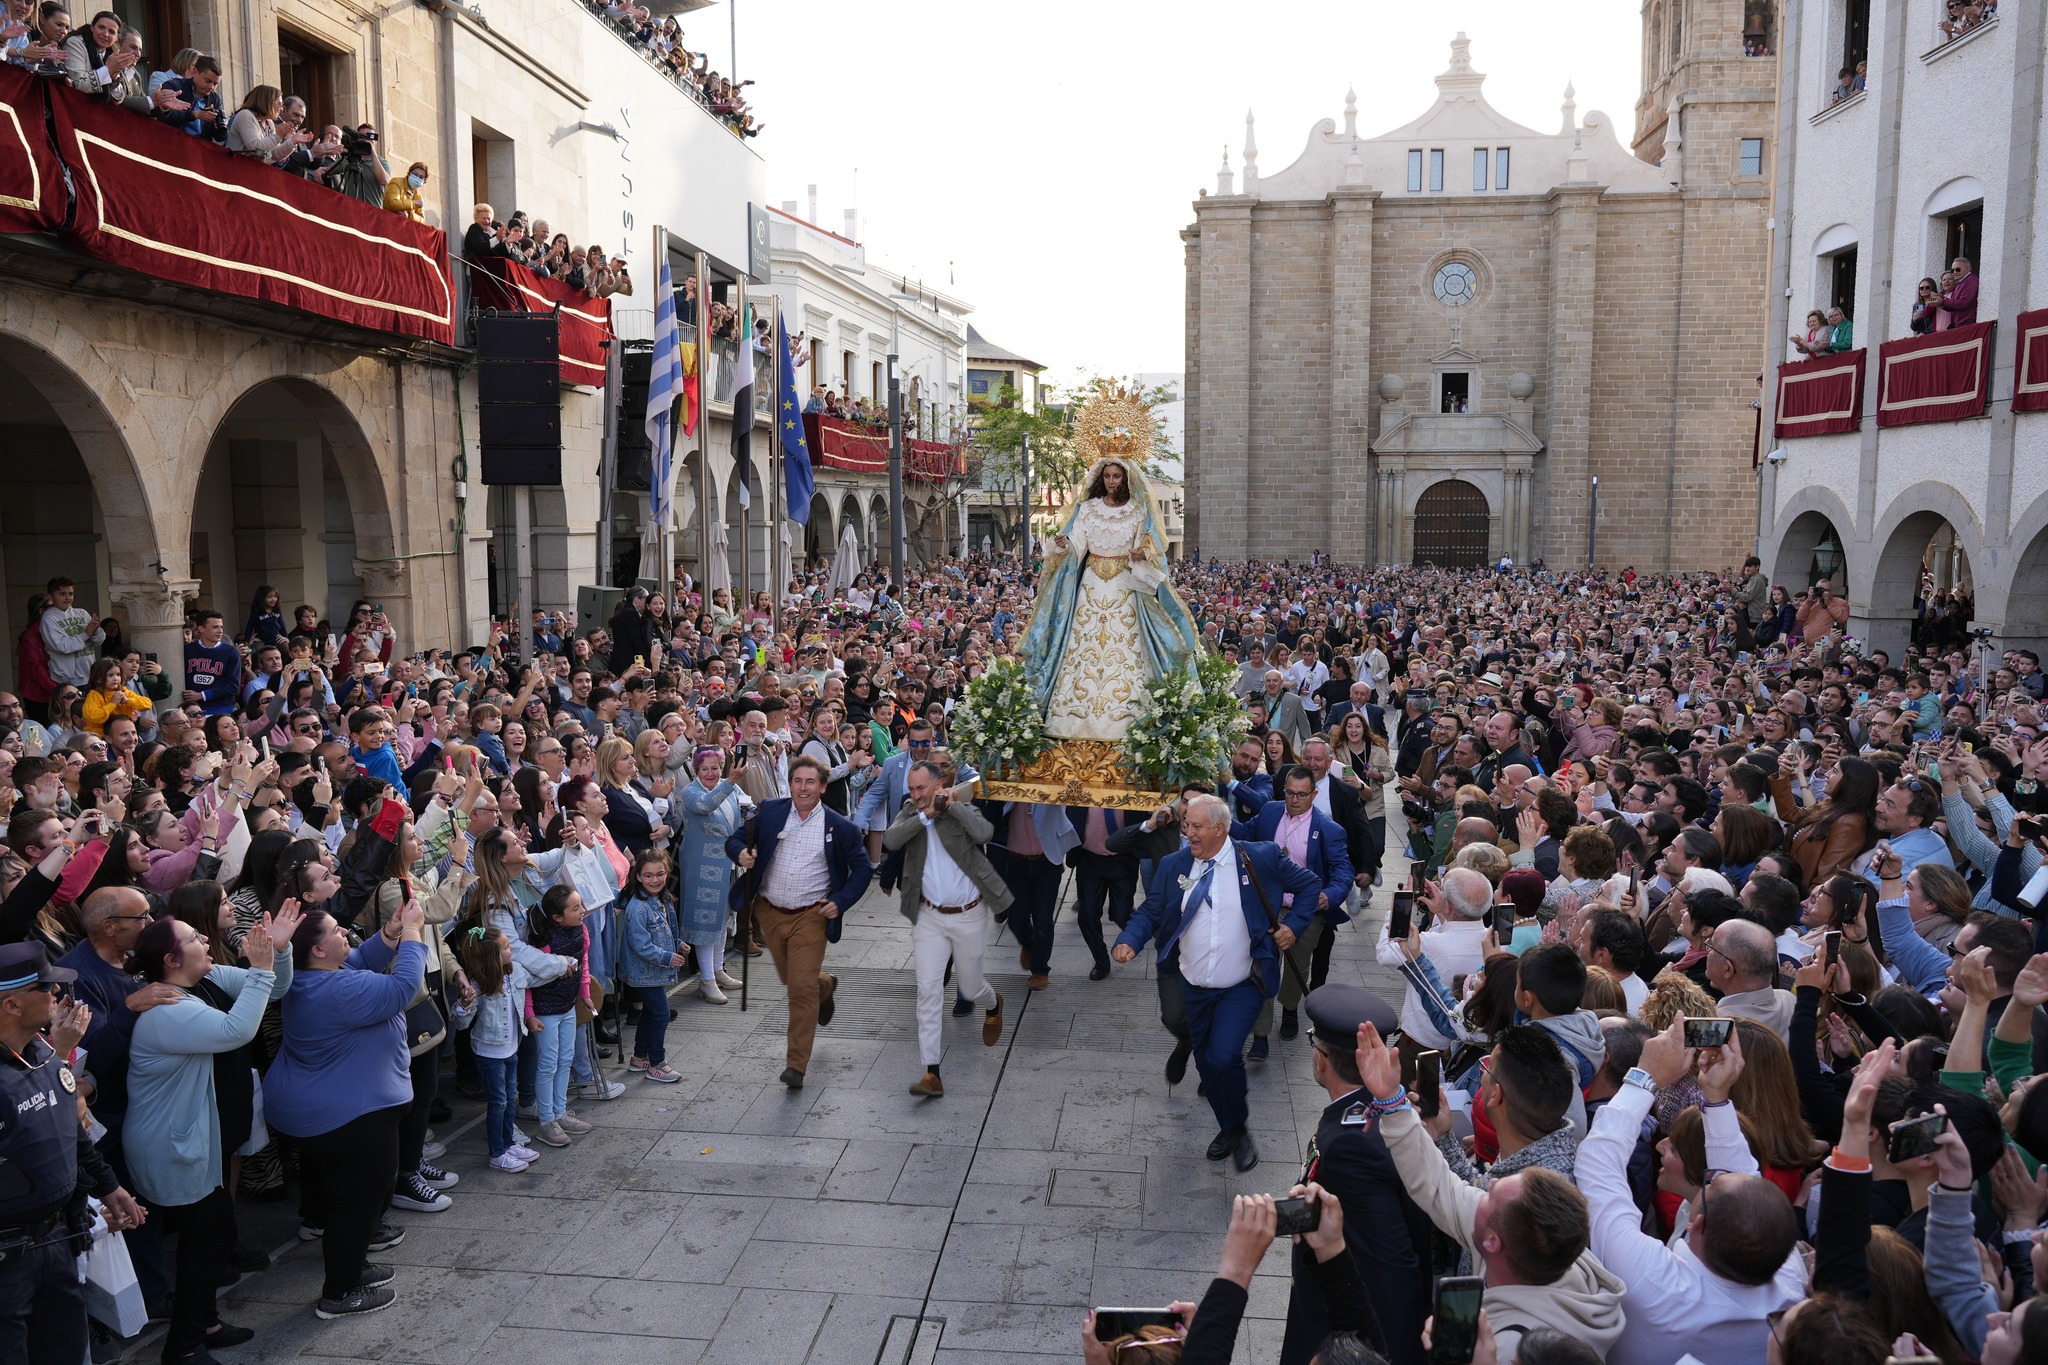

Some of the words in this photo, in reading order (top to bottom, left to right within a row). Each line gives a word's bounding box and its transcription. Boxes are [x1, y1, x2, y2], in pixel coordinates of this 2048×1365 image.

[620, 102, 633, 256] TSUNA
[754, 248, 769, 263] TSUNA
[188, 658, 223, 675] POLO
[196, 675, 211, 684] 1967
[18, 1092, 46, 1114] POLICIA
[35, 1101, 47, 1111] LOCAL
